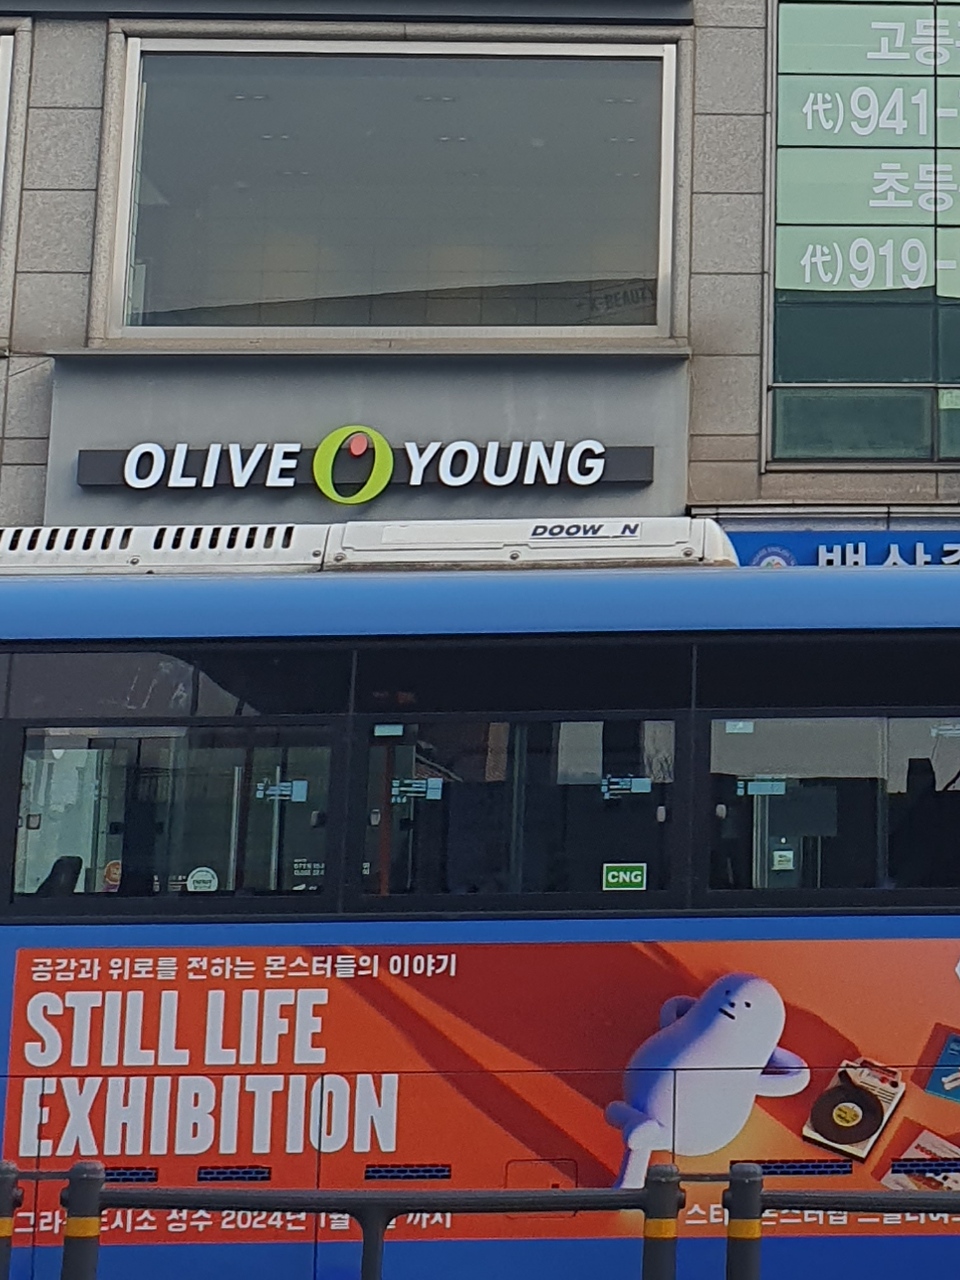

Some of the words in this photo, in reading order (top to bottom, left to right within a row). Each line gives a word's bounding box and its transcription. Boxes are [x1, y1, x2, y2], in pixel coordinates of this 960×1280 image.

[123, 442, 301, 489] OLIVE
[402, 439, 606, 488] YOUNG
[607, 870, 642, 883] CNG
[30, 957, 101, 982] 공감과
[108, 956, 178, 980] 위로를
[186, 956, 255, 980] 전하는
[263, 954, 379, 979] 몬스터들의
[389, 953, 457, 978] 이야기
[24, 989, 190, 1067] STILL
[204, 988, 329, 1066] LIFE
[18, 1072, 400, 1158] EXHIBITION
[166, 1209, 213, 1232] 성수
